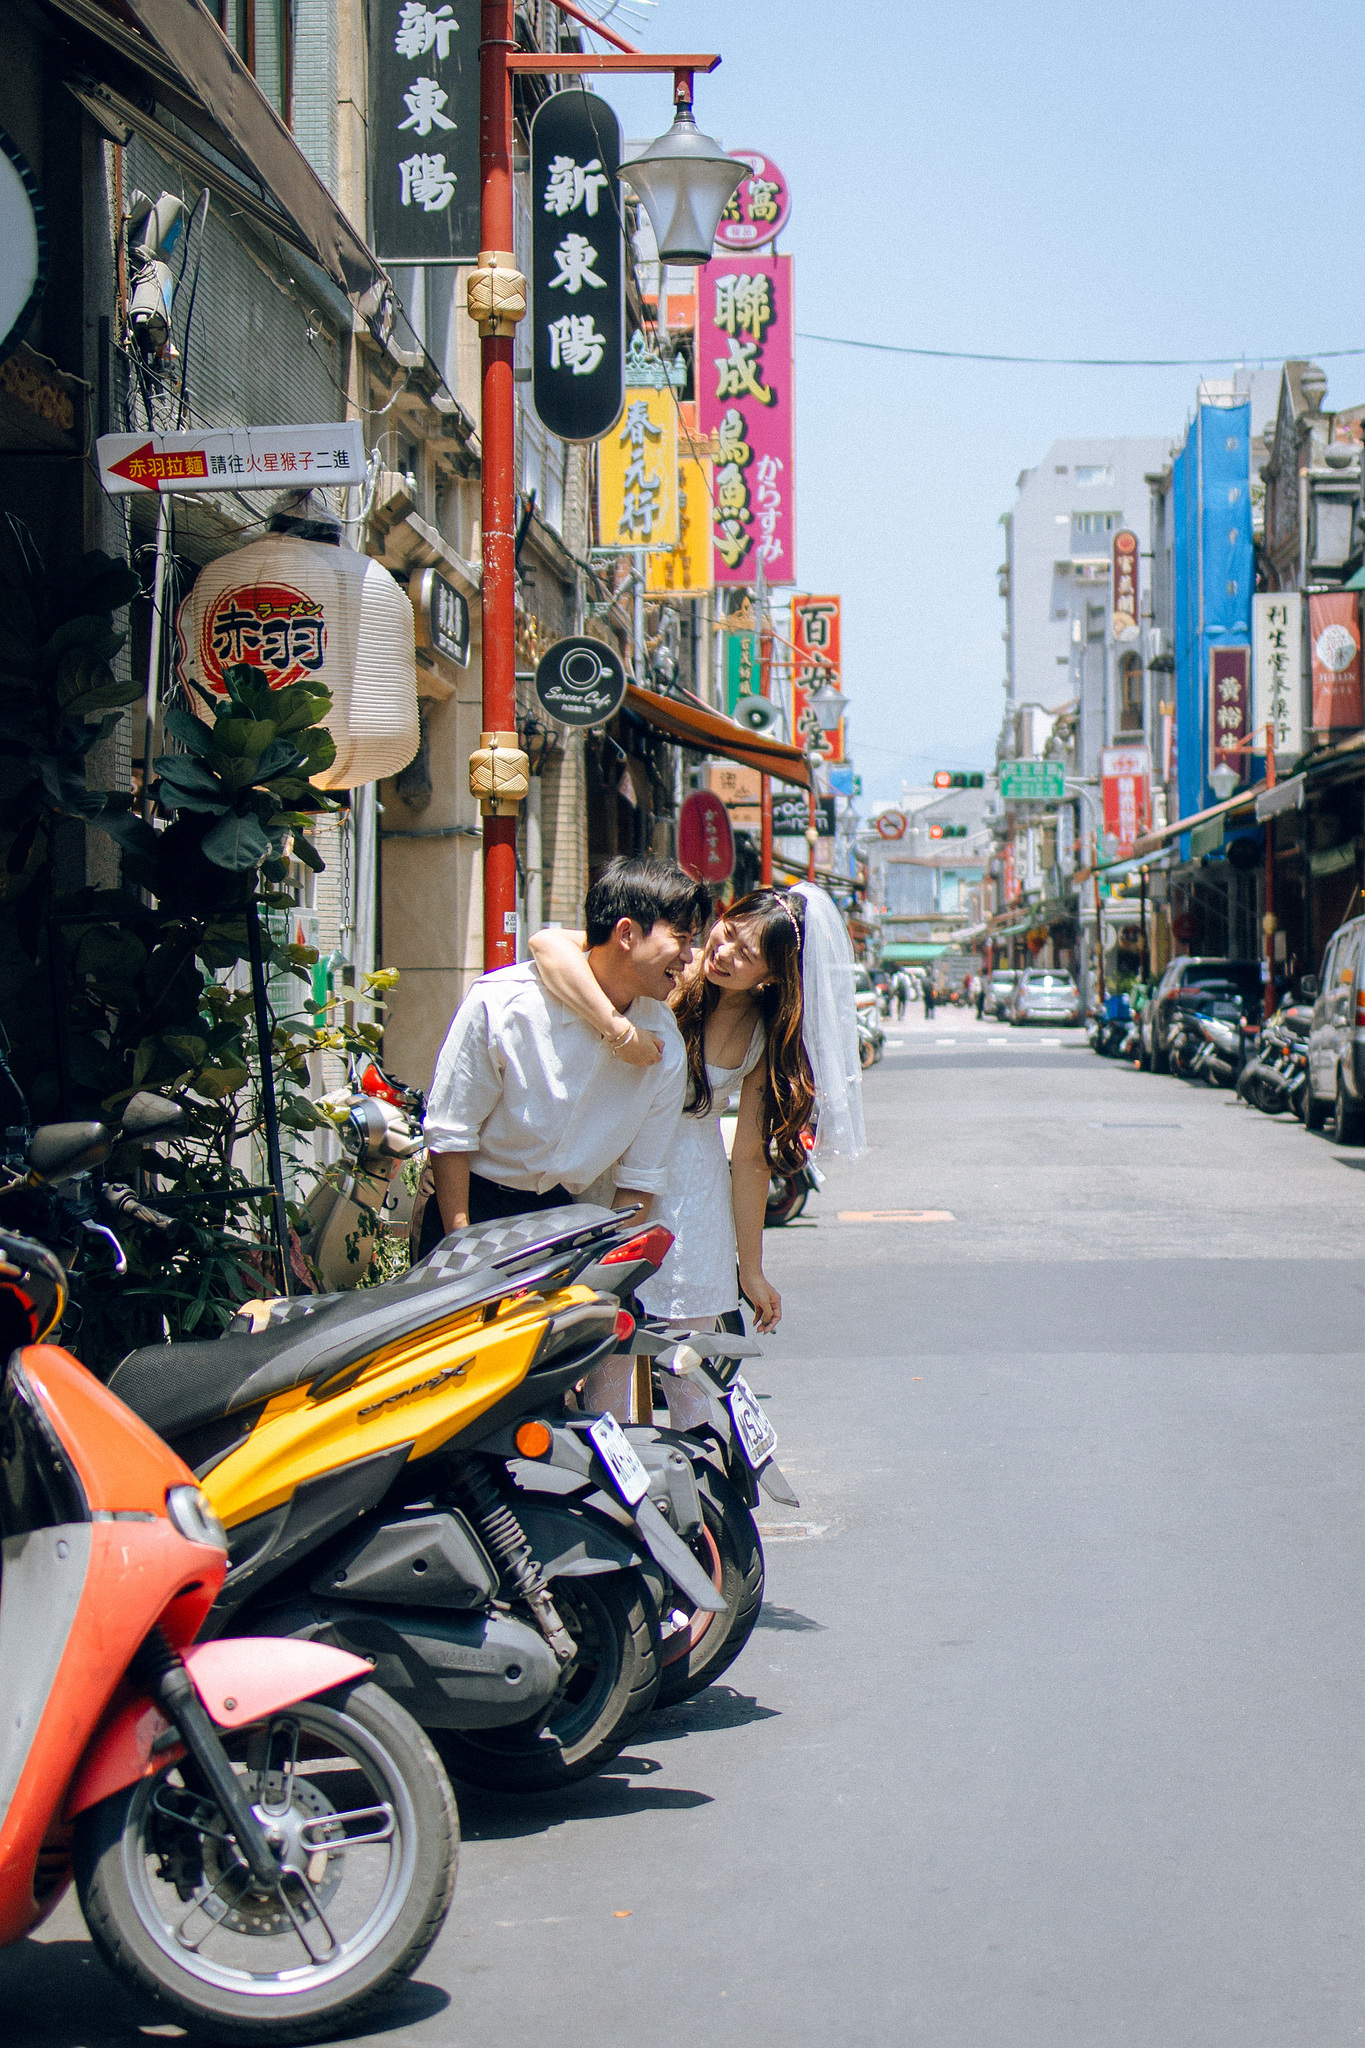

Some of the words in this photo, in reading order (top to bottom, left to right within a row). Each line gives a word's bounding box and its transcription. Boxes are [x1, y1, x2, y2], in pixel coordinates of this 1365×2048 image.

[394, 1, 461, 213] 新東陽
[721, 177, 779, 222] 窩
[543, 154, 609, 376] 新東陽
[712, 272, 773, 406] 聯成
[128, 456, 205, 479] 赤羽拉麵
[209, 450, 351, 475] 請往火星猴子二進
[619, 398, 663, 537] 春元行
[711, 408, 751, 570] 烏魚子
[756, 454, 784, 563] からすみ
[211, 598, 325, 671] 赤羽
[256, 601, 325, 619] ラーメン
